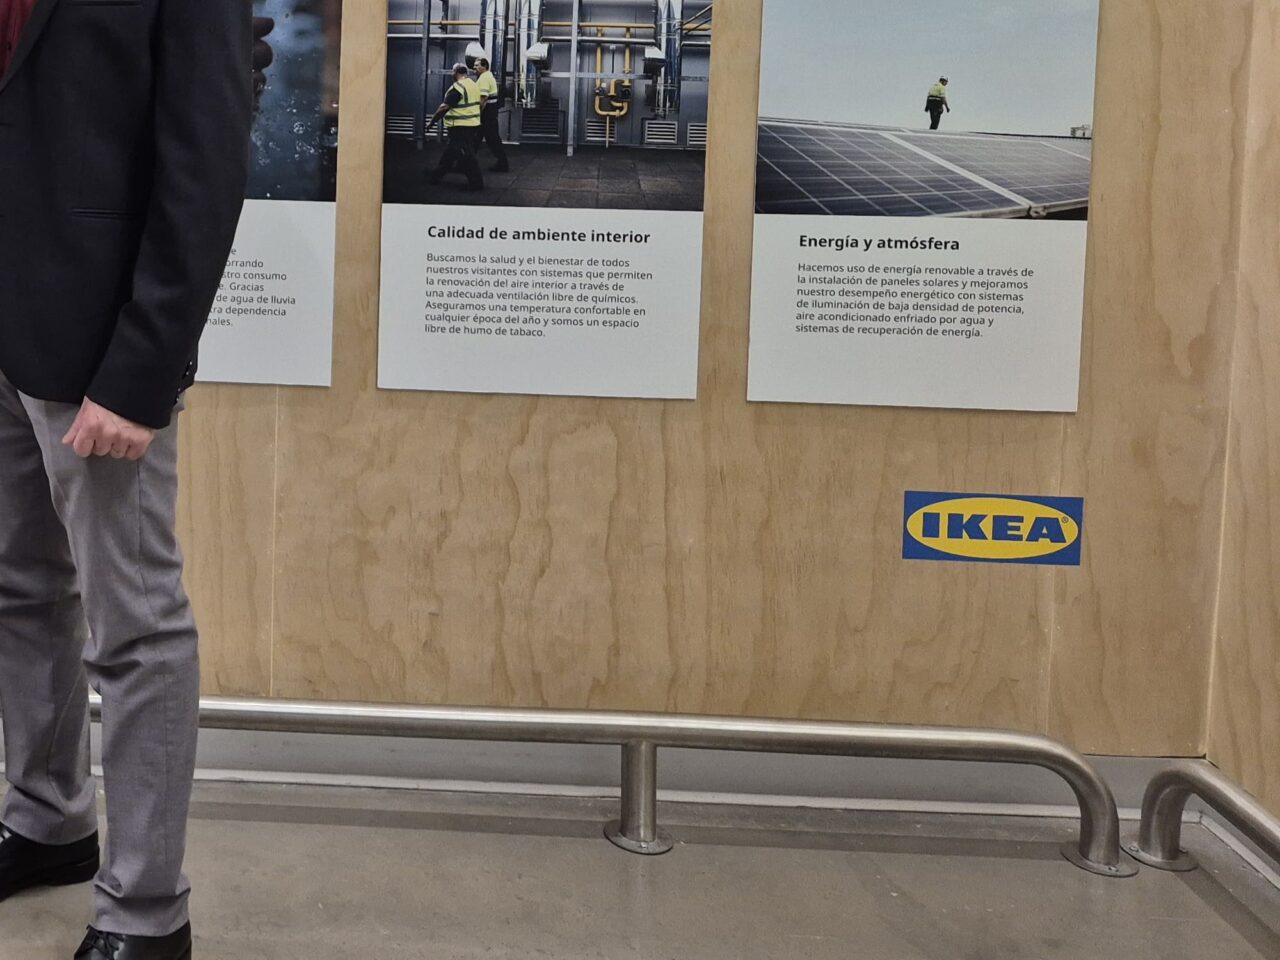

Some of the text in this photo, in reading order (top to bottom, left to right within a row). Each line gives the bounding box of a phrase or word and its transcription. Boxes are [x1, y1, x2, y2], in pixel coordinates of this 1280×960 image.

[428, 226, 650, 243] Calidad de ambiente interior
[800, 235, 959, 252] Energía y atmósfera
[225, 258, 264, 268] orrando
[243, 272, 286, 280] consumo
[229, 282, 264, 291] Gracias
[216, 294, 295, 305] de agua de lluvia
[838, 288, 897, 299] desempeño
[900, 290, 954, 301] energético
[978, 292, 1023, 301] sistemas
[225, 306, 286, 316] dependencia
[425, 301, 486, 312] Aseguramos
[510, 304, 571, 314] temperatura
[574, 305, 630, 315] confortable
[796, 312, 994, 327] aire acondicionado enfriado por agua y
[424, 324, 545, 337] libre de humo de tabaco.
[922, 512, 1067, 543] IKEA
